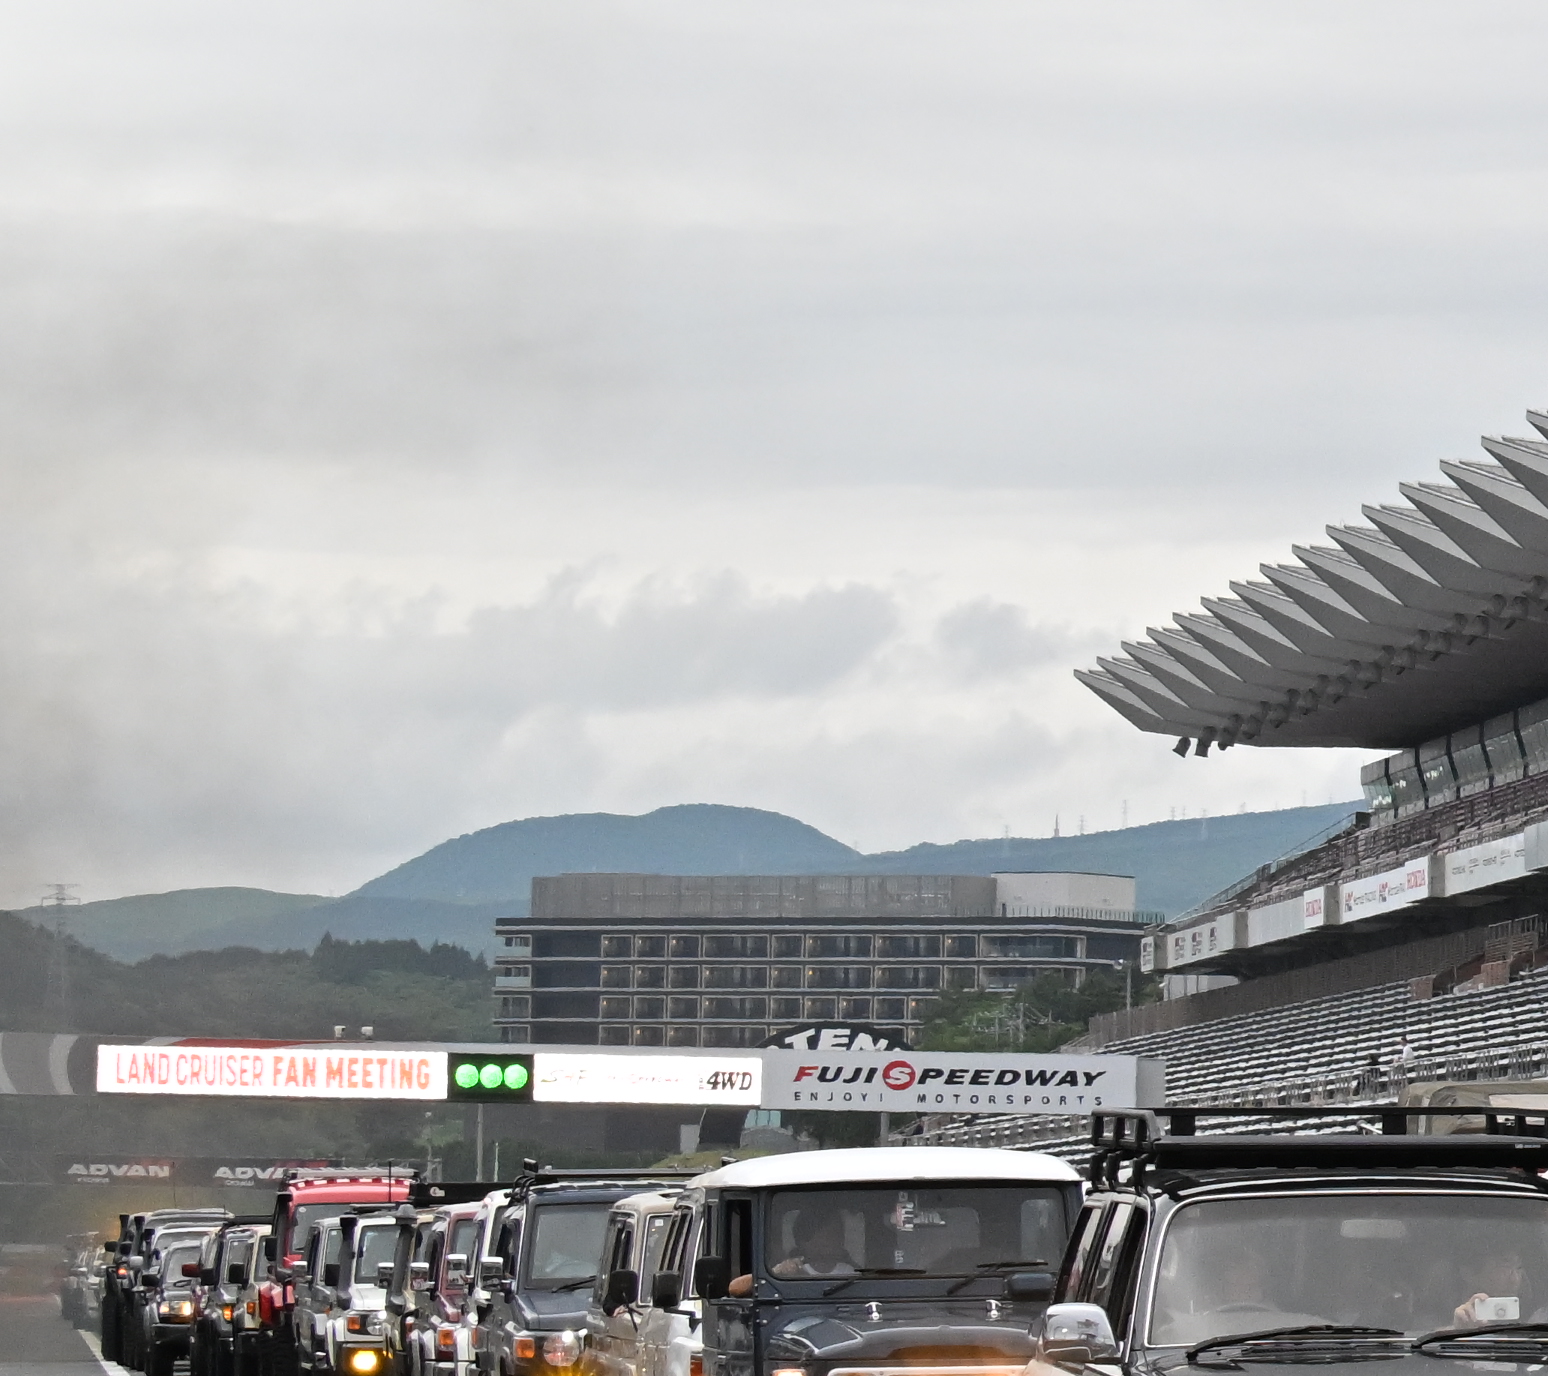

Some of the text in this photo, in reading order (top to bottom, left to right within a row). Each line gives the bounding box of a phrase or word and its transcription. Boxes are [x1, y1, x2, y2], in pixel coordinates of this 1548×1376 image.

[116, 1053, 430, 1089] LAND CRUISER FAN MEETING
[706, 1070, 753, 1091] 4WD
[793, 1062, 1106, 1089] FUJI SPEEDWAY
[794, 1092, 1103, 1106] ENJOY! MOTORSPORTS
[67, 1164, 170, 1178] ADVAN
